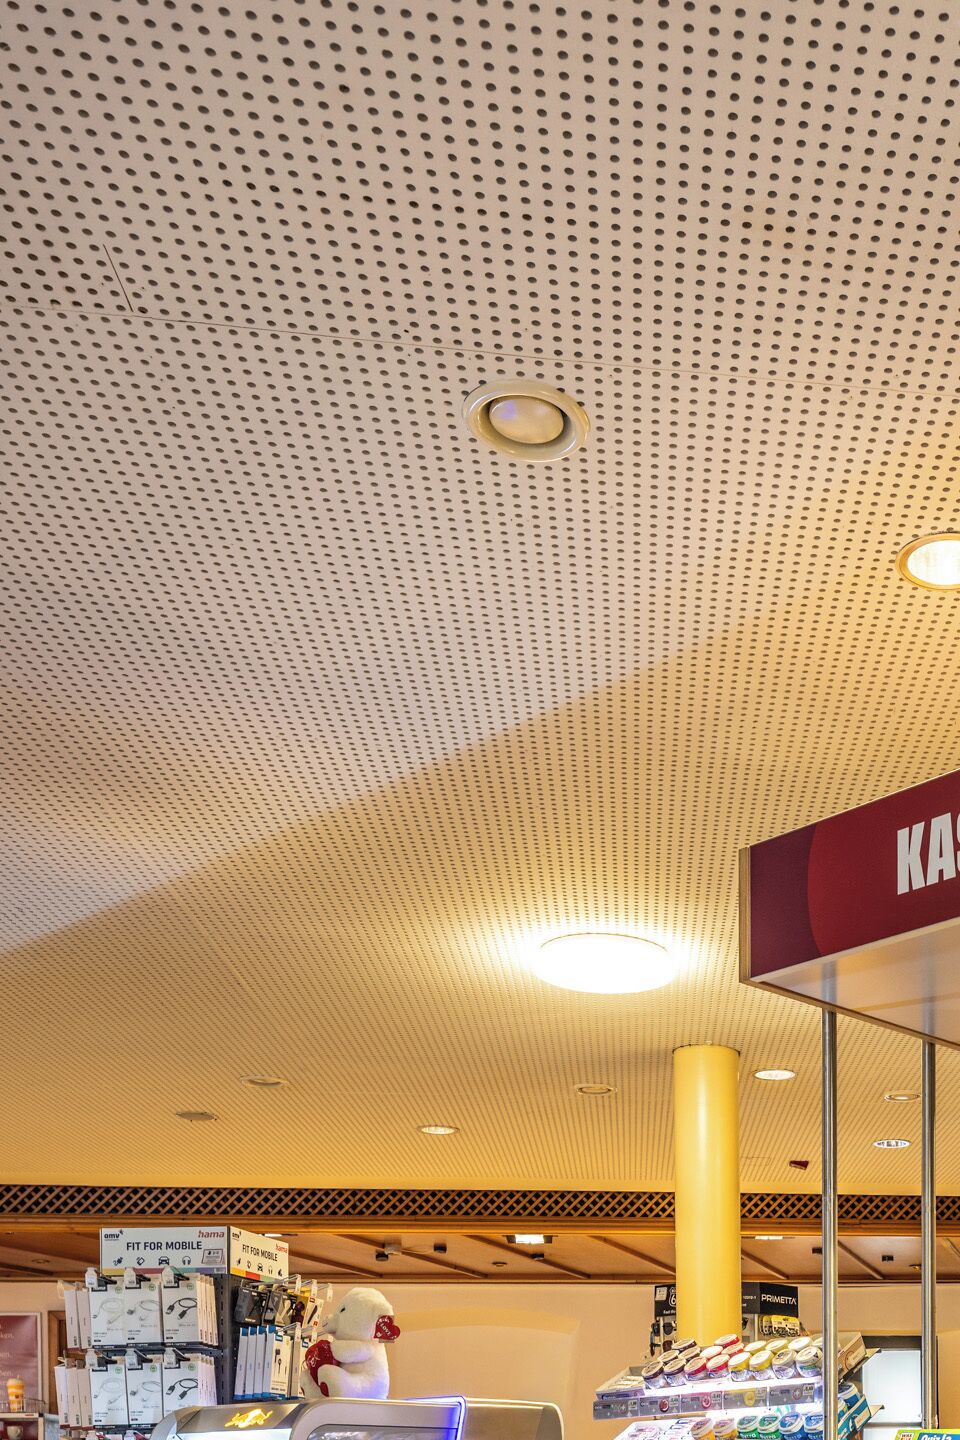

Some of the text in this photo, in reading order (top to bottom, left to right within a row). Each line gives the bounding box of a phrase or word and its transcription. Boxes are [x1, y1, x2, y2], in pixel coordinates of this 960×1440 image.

[198, 1230, 225, 1239] hama
[126, 1240, 203, 1251] FIT FOR MOBILE
[242, 1243, 278, 1262] FIT FOR MOBILE
[761, 1293, 797, 1305] PRIMETTA
